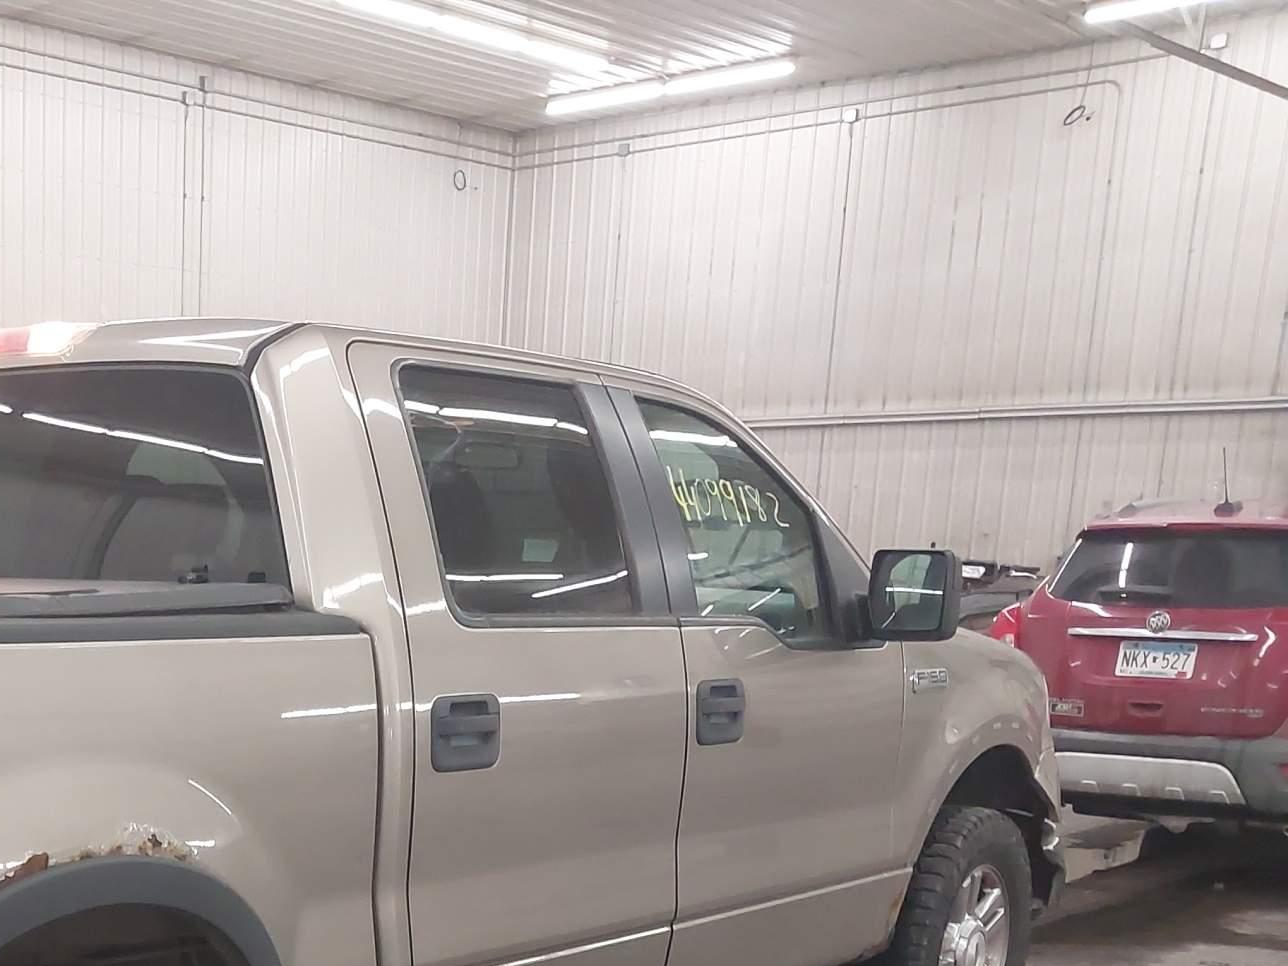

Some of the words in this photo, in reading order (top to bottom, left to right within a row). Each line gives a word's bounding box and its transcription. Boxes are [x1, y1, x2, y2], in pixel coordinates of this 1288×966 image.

[666, 465, 790, 527] 44099182
[1121, 650, 1150, 669] NKX
[1161, 651, 1191, 670] 527
